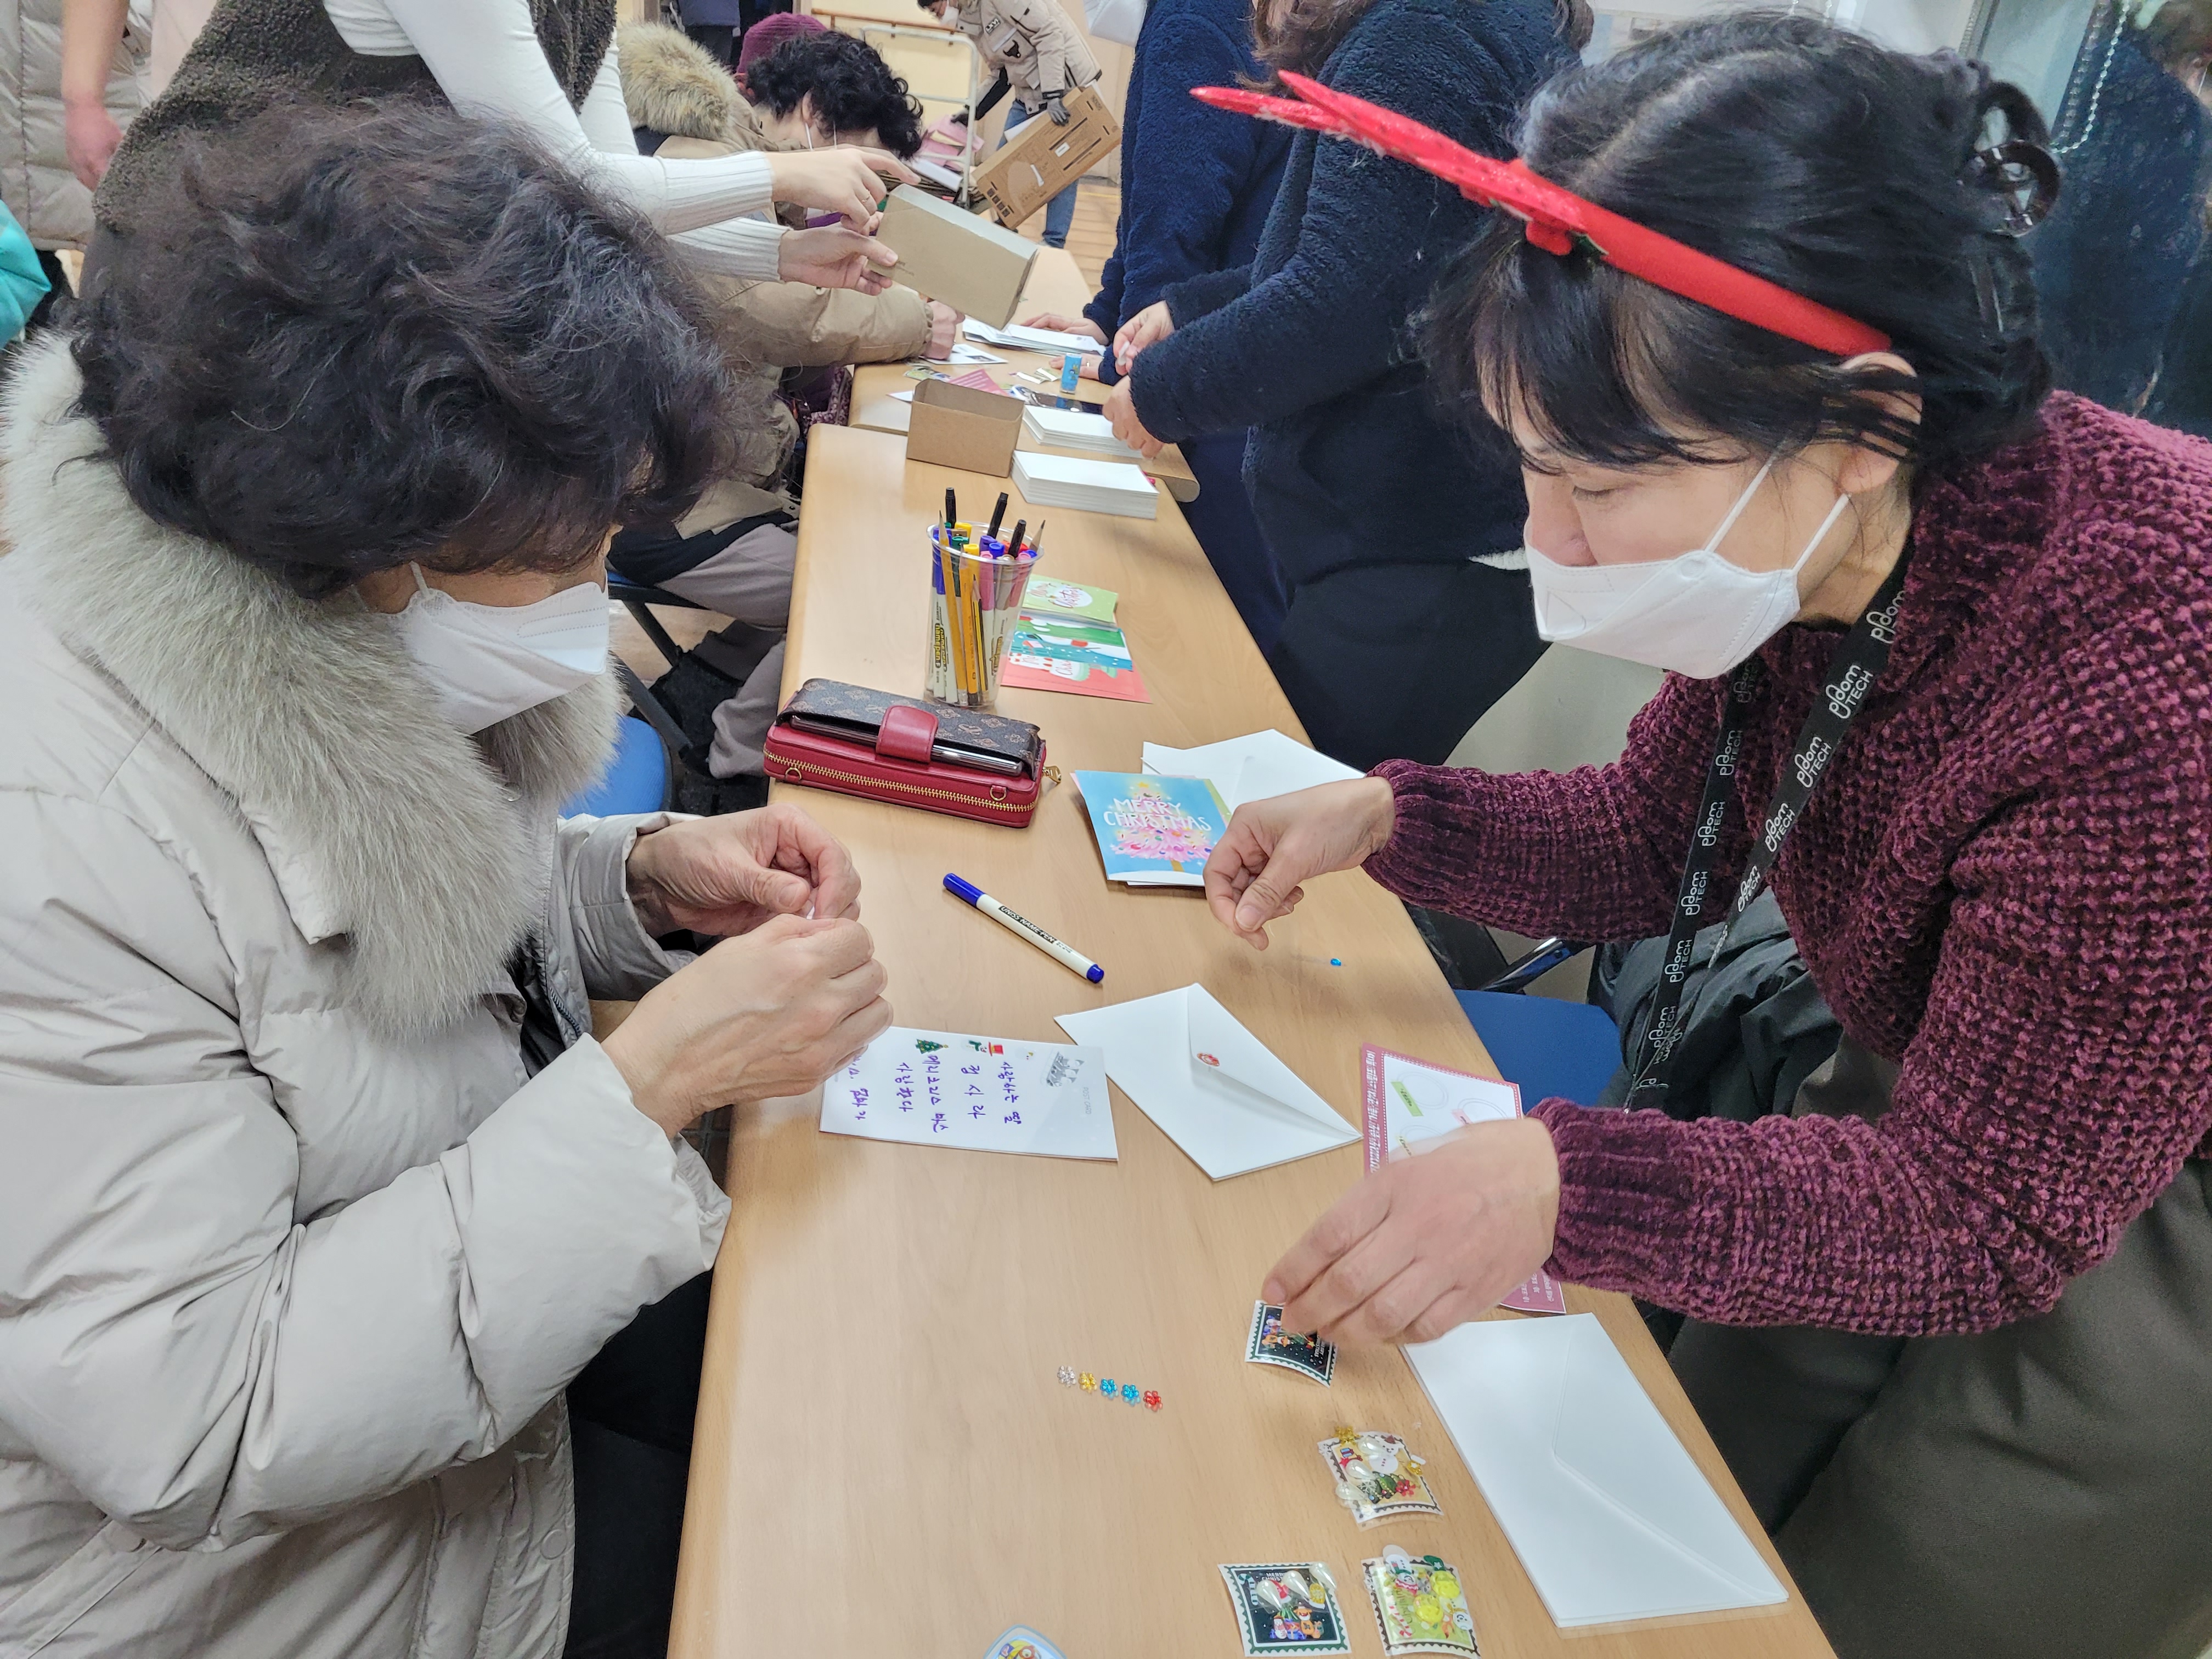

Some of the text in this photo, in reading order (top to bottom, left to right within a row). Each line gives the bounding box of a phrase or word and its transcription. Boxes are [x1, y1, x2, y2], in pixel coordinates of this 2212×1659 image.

[1846, 670, 1874, 708] TECH
[1731, 730, 1743, 762] TECH
[1809, 742, 1832, 776] TECH
[1103, 811, 1212, 832] CHRISTMAS
[1113, 798, 1181, 816] MERRY
[1712, 801, 1725, 834] TECH
[1775, 810, 1796, 843] TECH
[1696, 871, 1708, 904] TECH
[1745, 872, 1762, 902] TECH
[1000, 906, 1021, 921] UNISS
[1680, 939, 1694, 971] TECH
[895, 1062, 914, 1112] 사랑한다
[998, 1062, 1022, 1125] 사랑하는 딸
